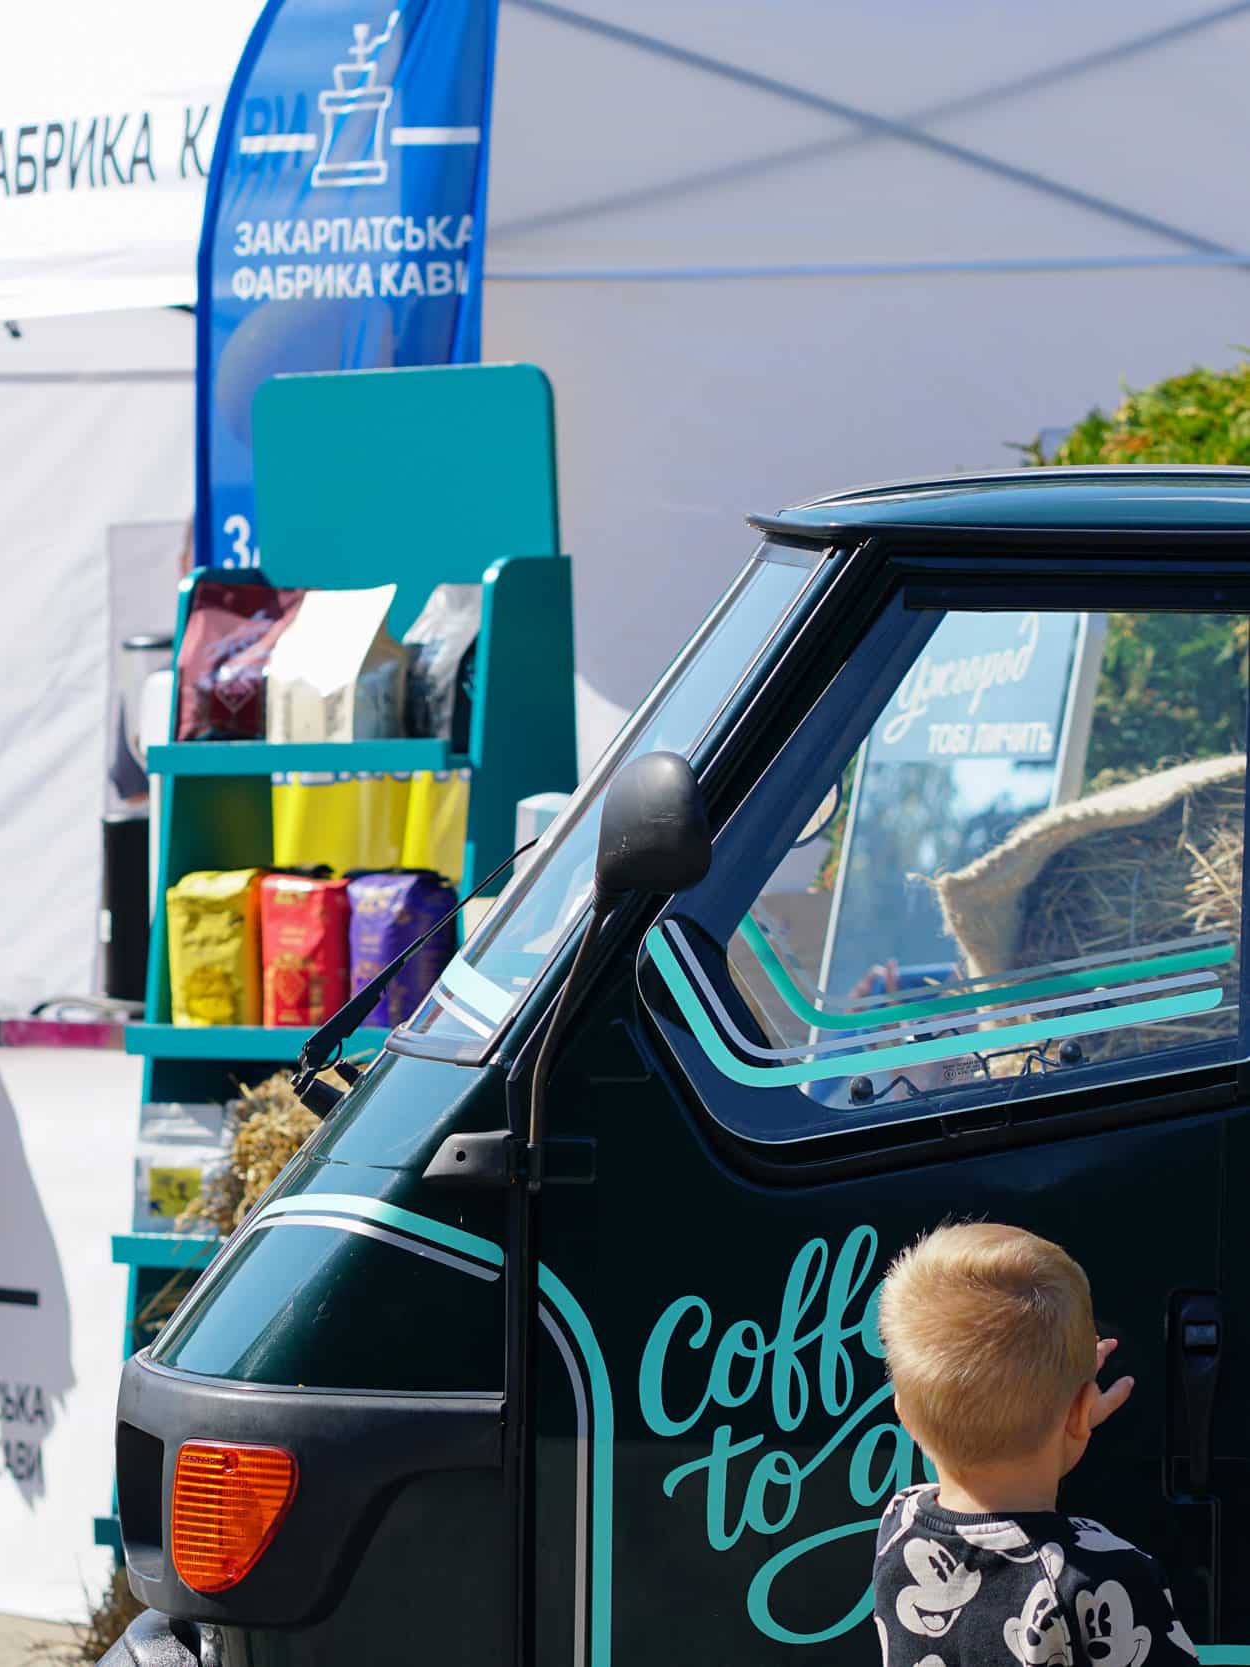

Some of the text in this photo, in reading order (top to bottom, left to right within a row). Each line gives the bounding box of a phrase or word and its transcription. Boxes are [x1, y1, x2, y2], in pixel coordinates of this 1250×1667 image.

[231, 261, 375, 300] ФАБРИКА
[233, 214, 473, 257] ЗАКАРПАТСЬКА
[639, 1225, 888, 1437] Coff
[663, 1412, 835, 1552] to
